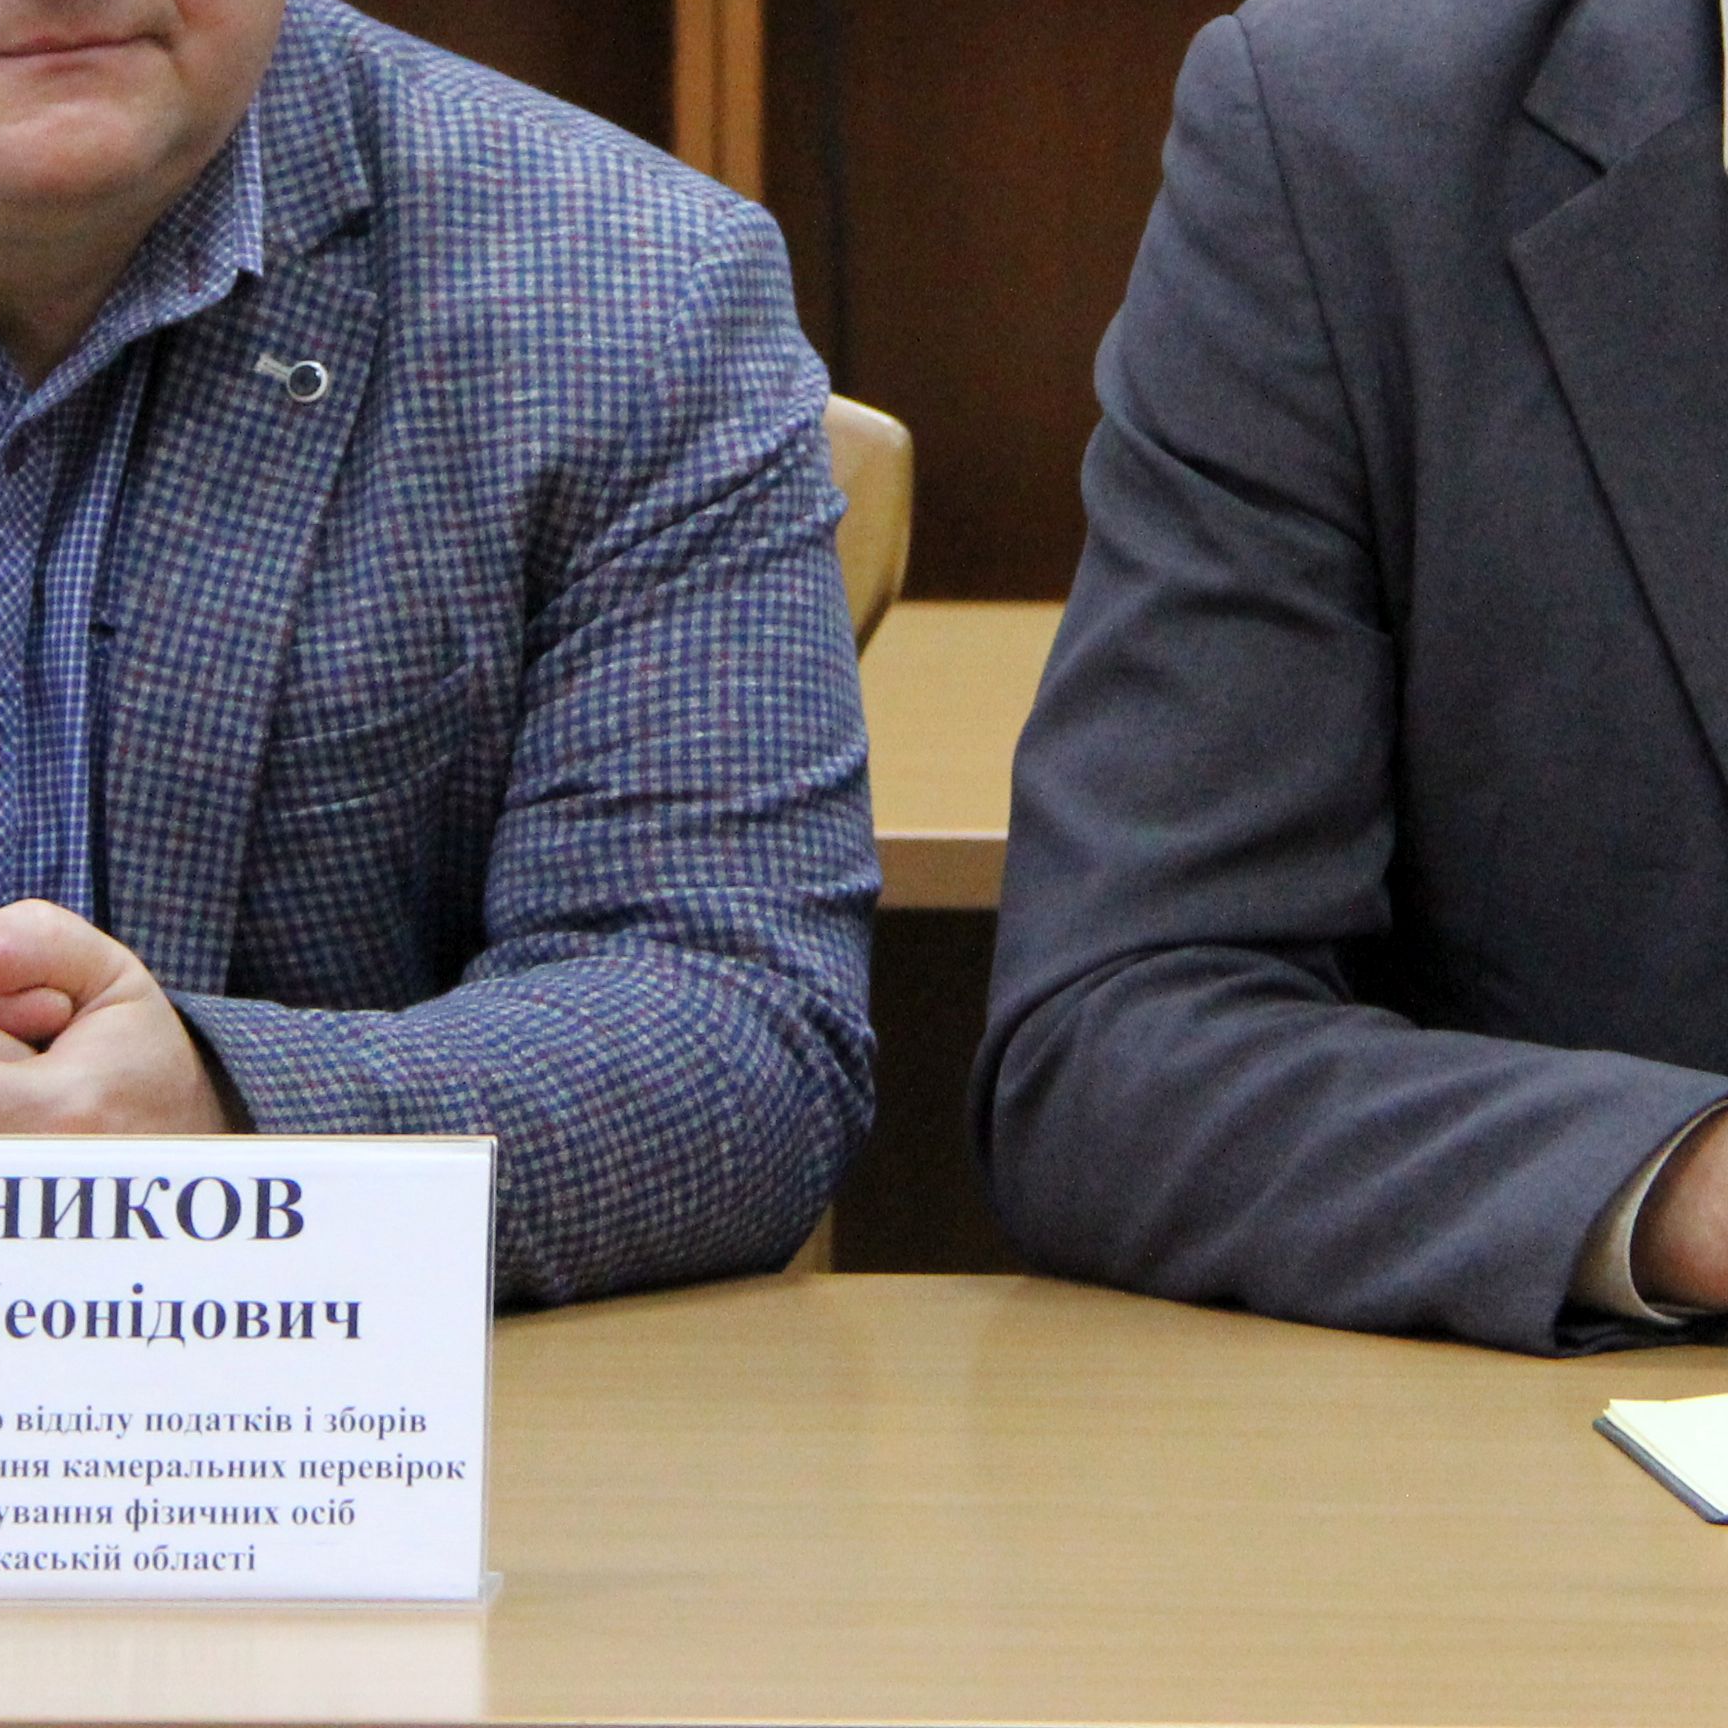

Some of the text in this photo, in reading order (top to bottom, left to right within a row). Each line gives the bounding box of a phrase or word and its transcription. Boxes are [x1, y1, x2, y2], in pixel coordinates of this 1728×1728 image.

[15, 1404, 133, 1440] відділу
[145, 1405, 293, 1435] податків
[304, 1405, 313, 1433] і
[324, 1405, 427, 1441] зборів
[62, 1458, 286, 1487] камеральних
[298, 1452, 467, 1488] перевірок
[124, 1497, 279, 1533] фізичних
[291, 1498, 356, 1526] осіб
[132, 1543, 255, 1572] області
